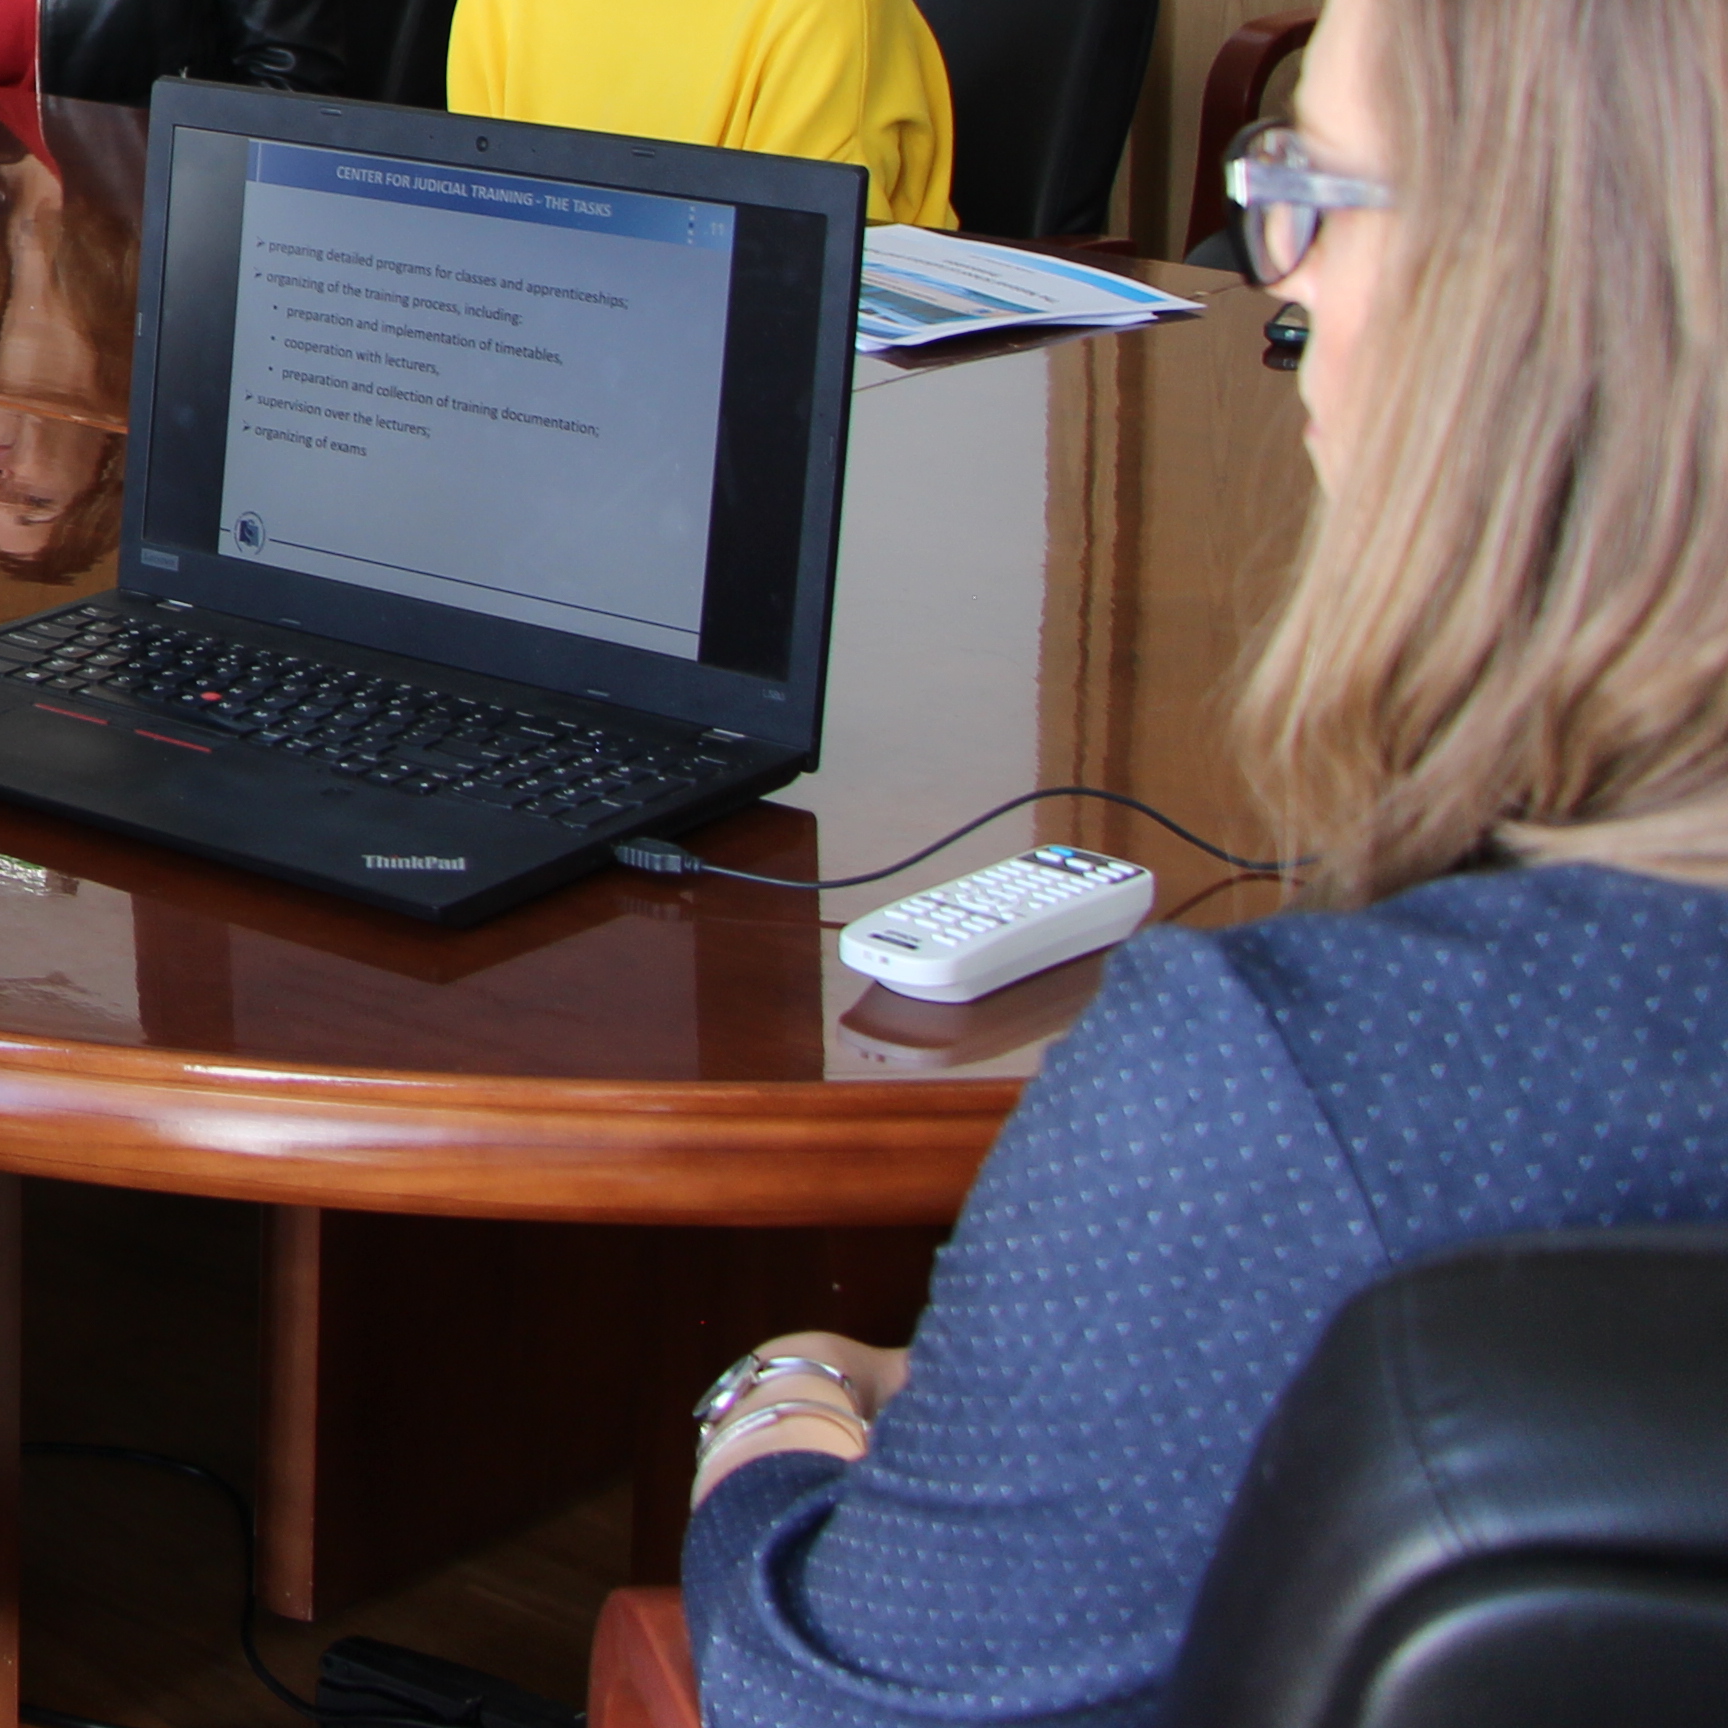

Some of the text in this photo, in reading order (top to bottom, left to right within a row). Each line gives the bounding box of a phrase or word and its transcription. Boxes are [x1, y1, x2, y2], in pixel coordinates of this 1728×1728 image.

[336, 165, 382, 185] CENTER
[385, 174, 410, 189] FOR
[412, 177, 468, 198] JUDICIAL
[471, 184, 534, 207] TRAINING
[544, 195, 569, 212] THE
[573, 199, 612, 218] TASKS
[266, 272, 324, 294] organizing
[327, 279, 341, 294] of
[341, 282, 362, 299] the
[364, 287, 410, 308] training
[412, 295, 462, 316] process,
[268, 240, 630, 309] preparing detailed programs for classes and apprenticeships;
[284, 337, 440, 376] cooperation with lecturers,
[286, 306, 563, 365] preparation and implementation of timetables,
[257, 394, 321, 416] supervision
[324, 407, 350, 422] over
[352, 411, 373, 426] the
[282, 367, 600, 438] preparation and collection of training documentation;
[255, 425, 367, 457] organizing of exams
[361, 854, 466, 871] ThinkPad
